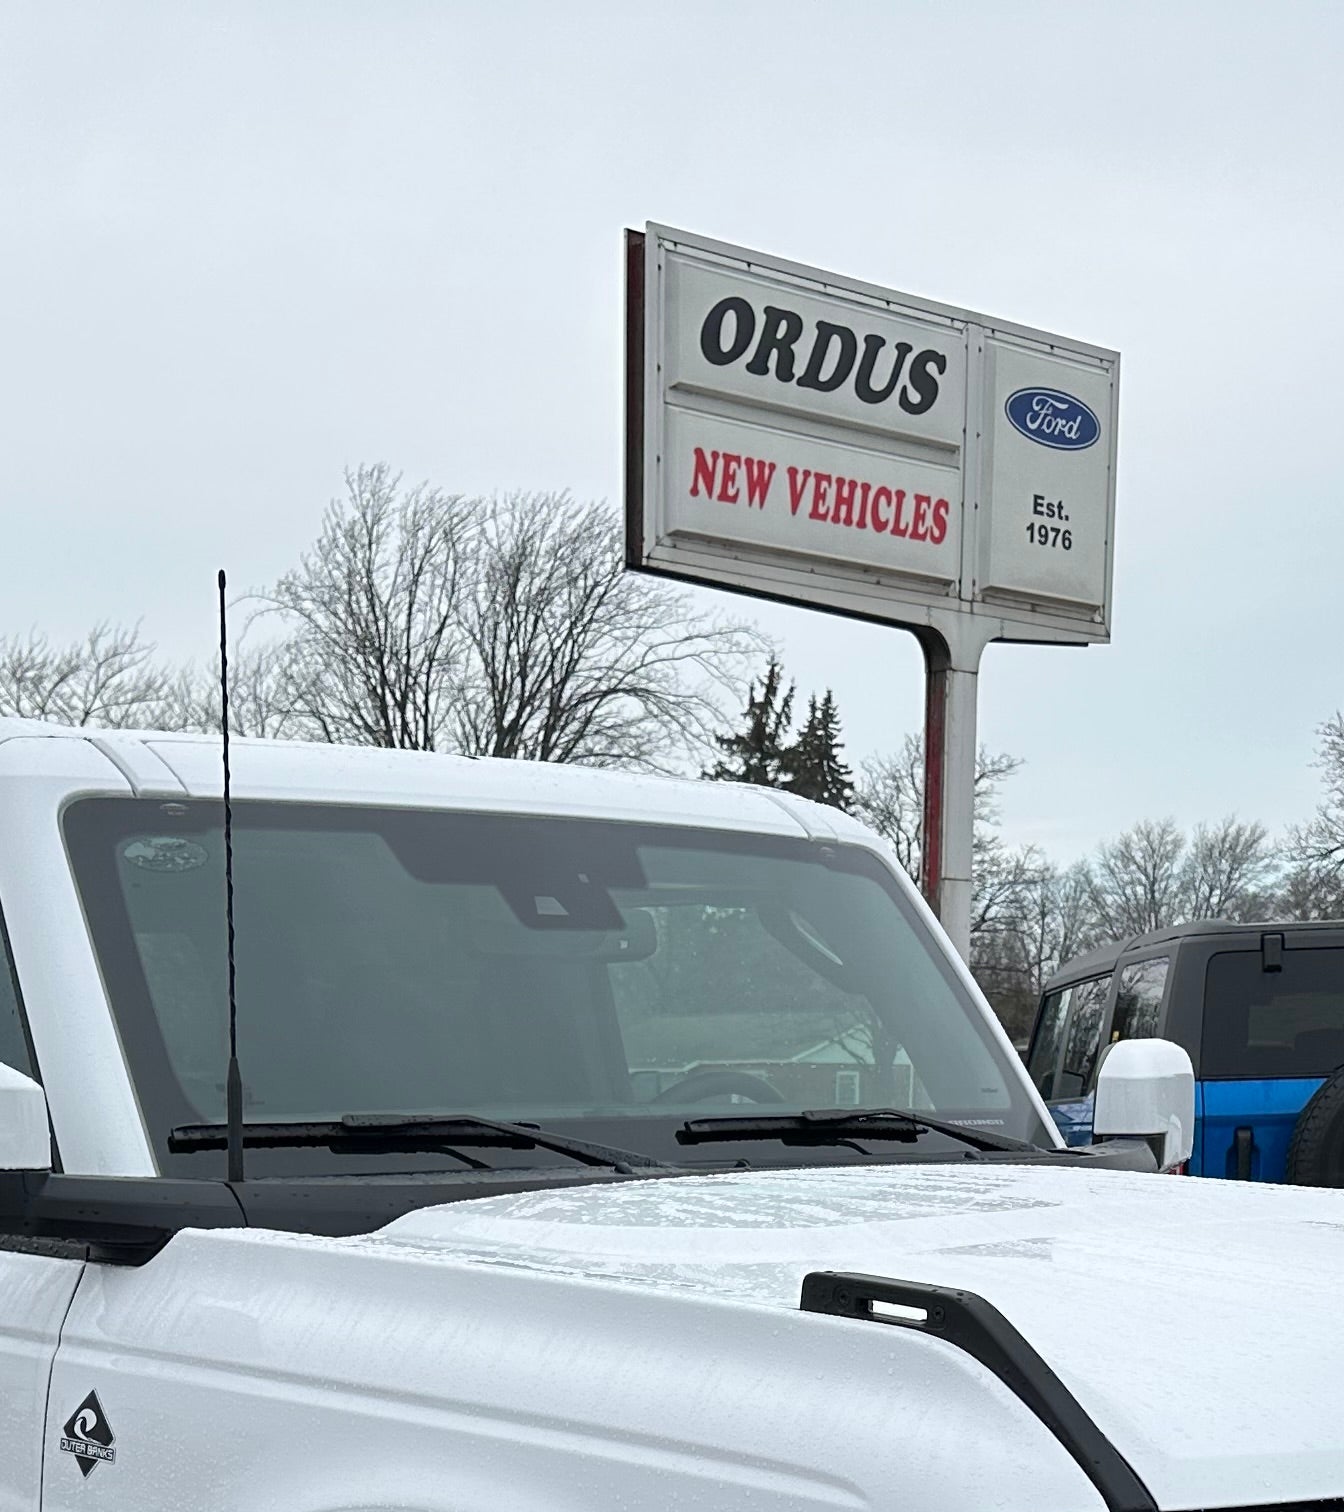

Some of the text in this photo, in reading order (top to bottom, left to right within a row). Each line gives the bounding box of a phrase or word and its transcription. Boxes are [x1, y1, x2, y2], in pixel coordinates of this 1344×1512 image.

[700, 296, 947, 415] ORDUS
[1026, 395, 1082, 440] Ford
[690, 447, 950, 545] NEW VEHICLES
[1033, 494, 1070, 521] Est.
[1026, 522, 1073, 550] 1976
